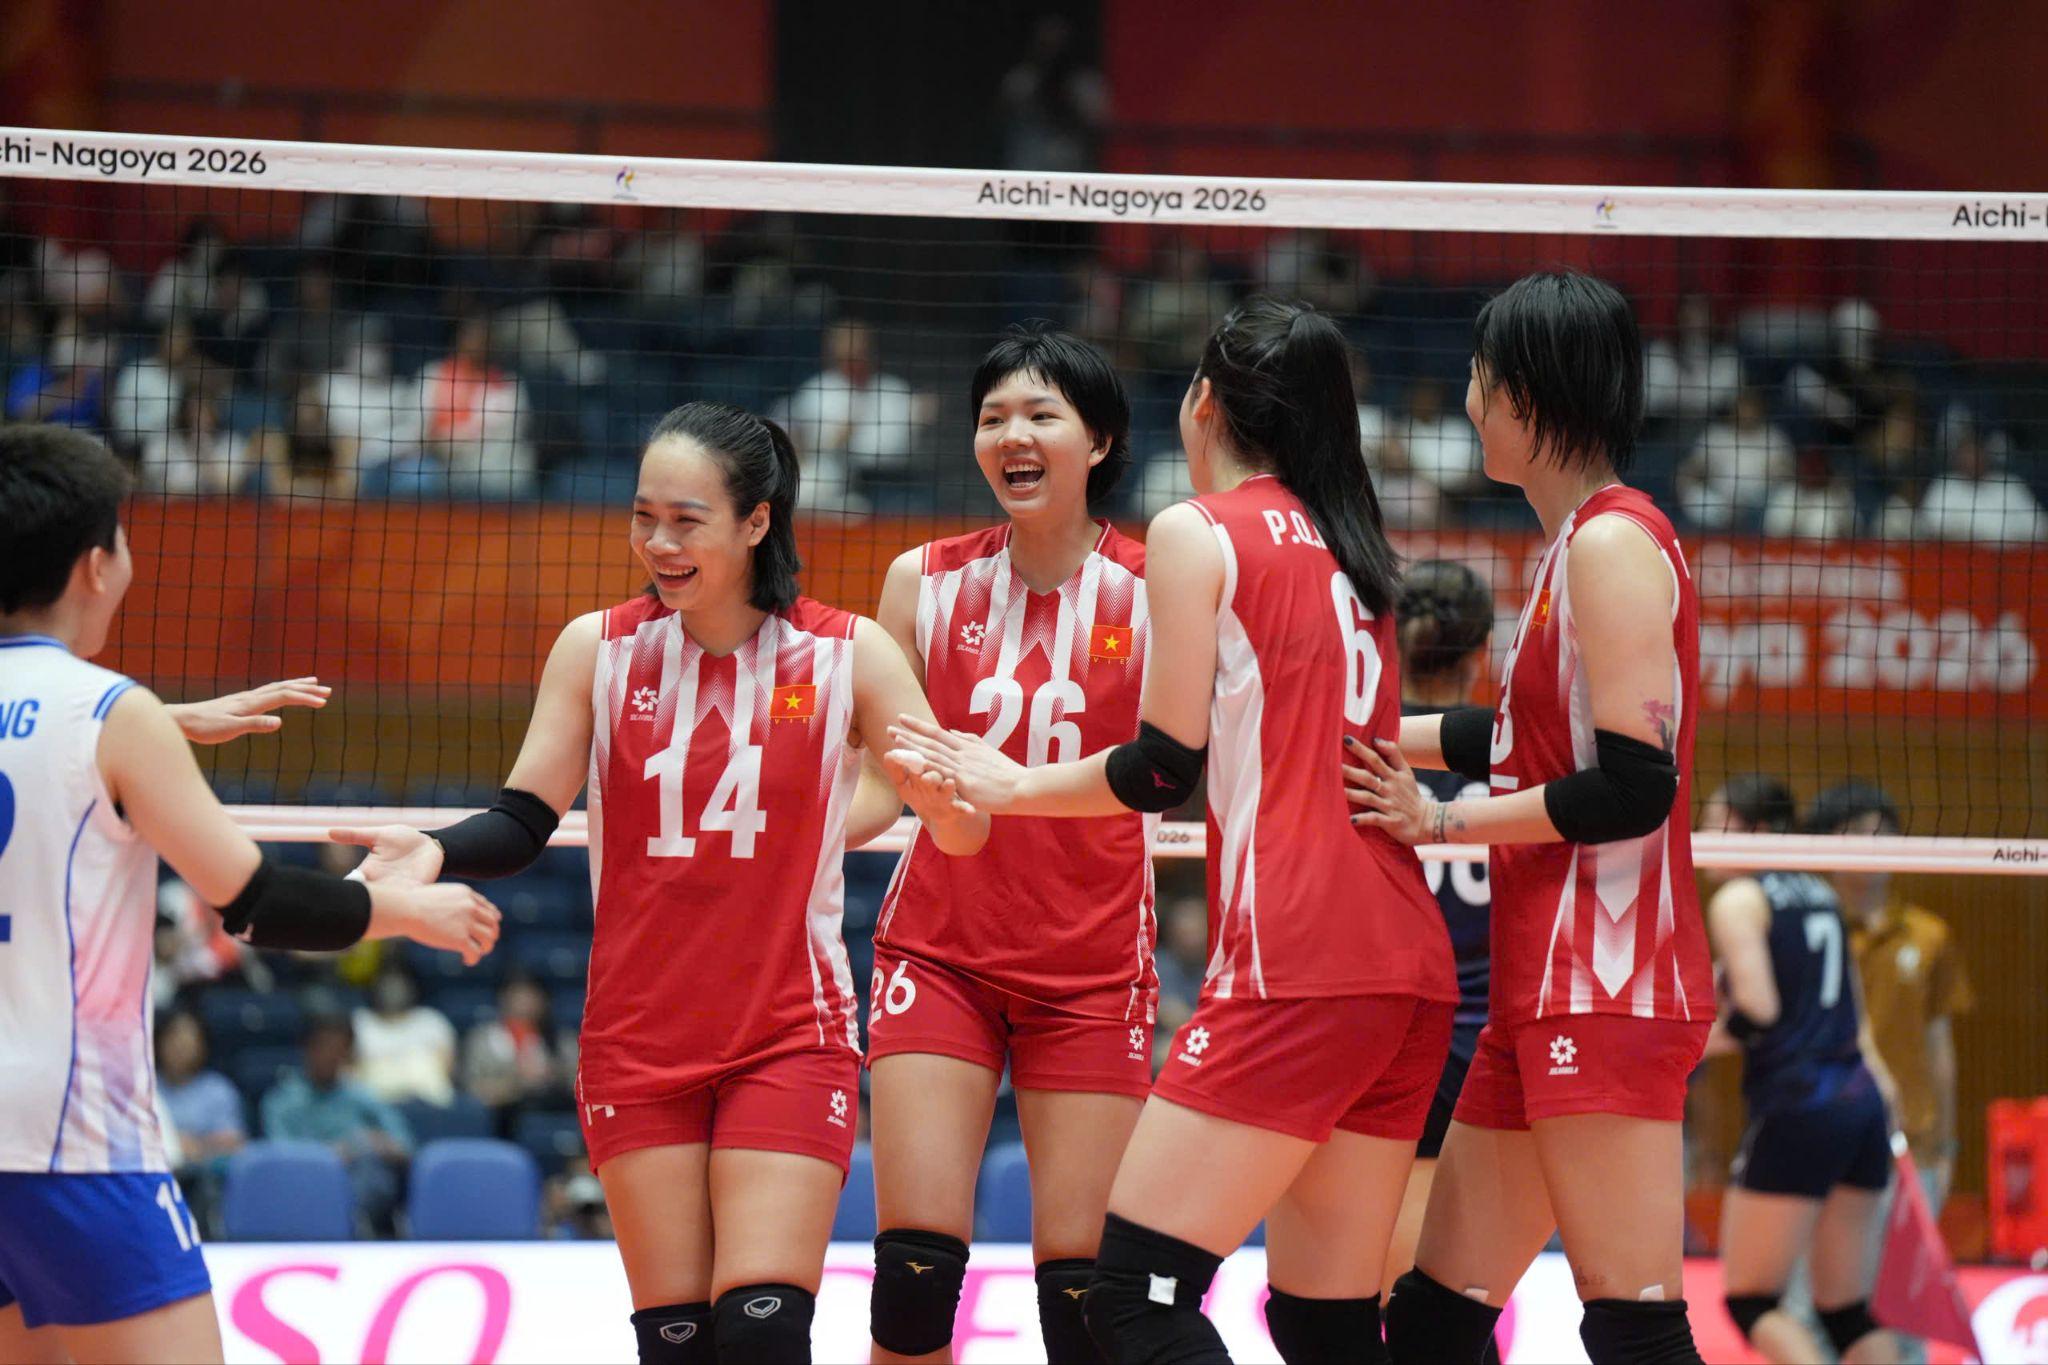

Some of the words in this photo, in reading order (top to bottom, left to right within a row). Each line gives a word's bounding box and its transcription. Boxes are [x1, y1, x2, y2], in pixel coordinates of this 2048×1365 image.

[0, 137, 176, 177] hi-Nagoya
[187, 148, 267, 174] 2026
[977, 179, 1183, 215] Aichi-Nagoya
[1194, 187, 1266, 211] 2026
[1330, 571, 1383, 727] 6
[1822, 607, 2039, 693] 2026
[968, 676, 1087, 769] 26
[643, 744, 768, 859] 14
[869, 960, 917, 1027] 26
